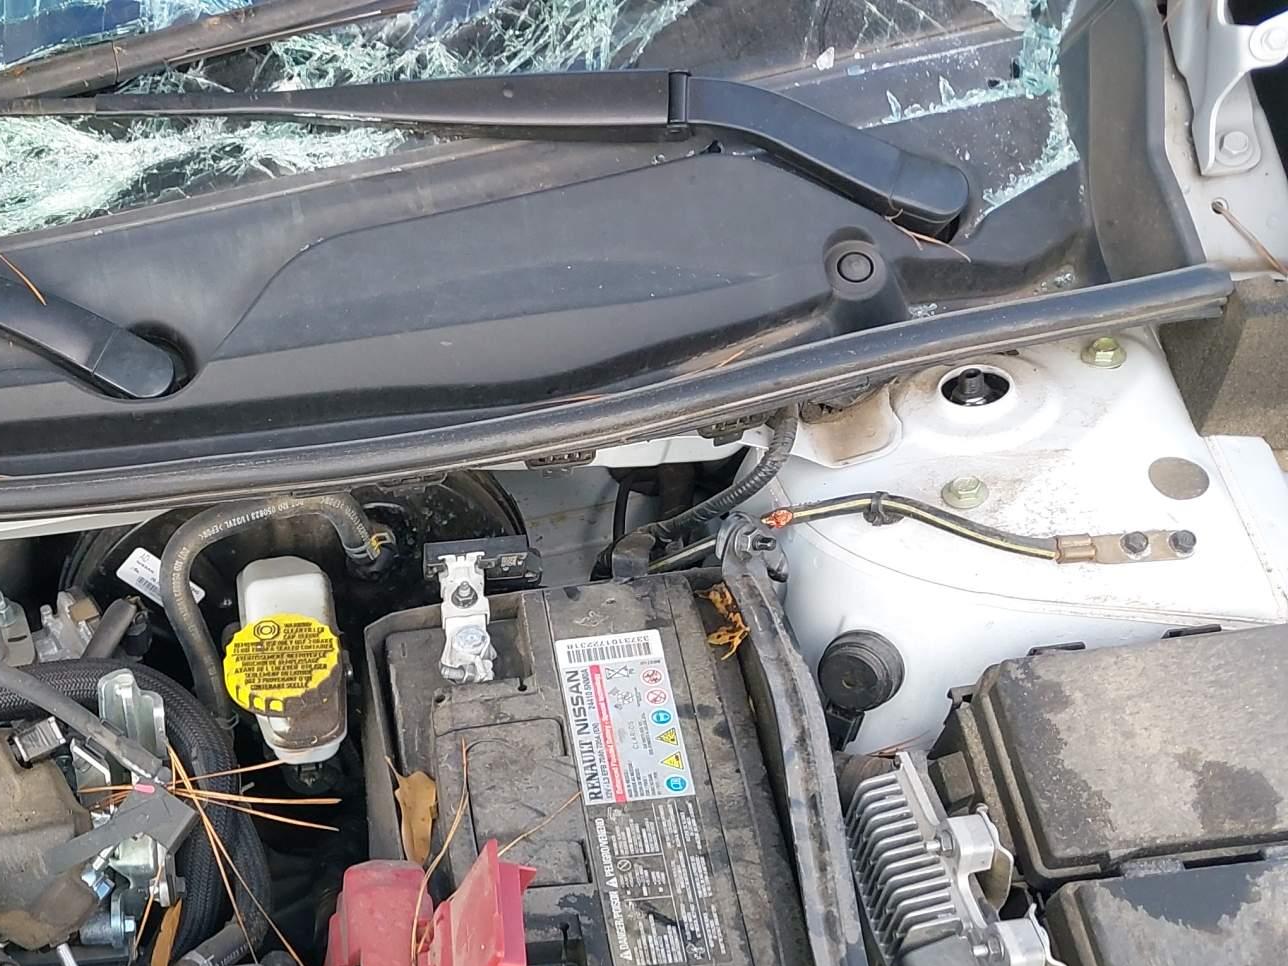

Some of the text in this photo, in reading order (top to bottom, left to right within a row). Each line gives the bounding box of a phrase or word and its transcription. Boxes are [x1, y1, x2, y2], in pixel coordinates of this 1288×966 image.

[565, 669, 589, 736] NISSAN
[579, 738, 604, 800] RENAULT
[609, 889, 632, 955] DANGER/POISON
